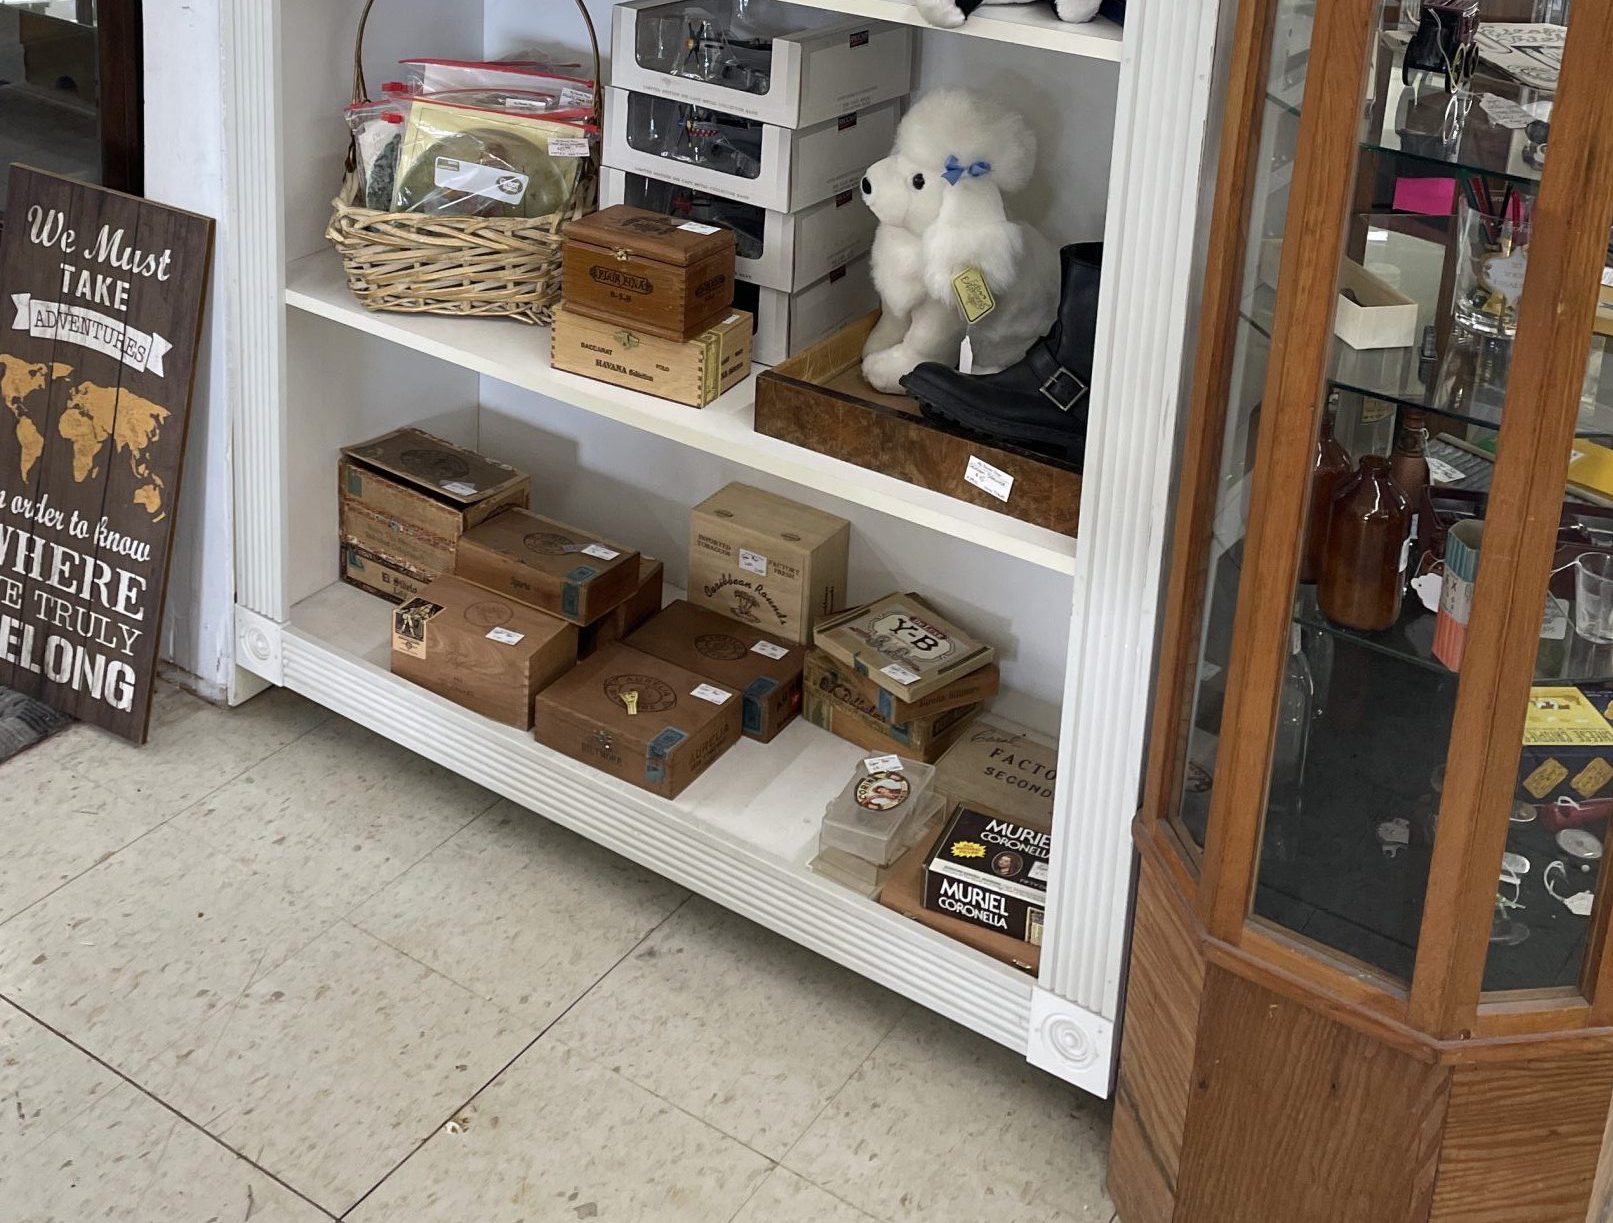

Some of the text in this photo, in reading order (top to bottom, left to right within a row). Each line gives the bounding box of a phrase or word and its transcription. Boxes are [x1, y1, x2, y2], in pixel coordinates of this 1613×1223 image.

[28, 205, 172, 281] We Must
[60, 263, 131, 312] TAKE
[34, 309, 147, 363] ADVENTURES
[596, 359, 627, 375] HAVANA
[11, 494, 64, 529] order
[69, 510, 90, 538] to
[93, 516, 151, 562] know
[0, 576, 144, 656] E TRULY
[704, 572, 787, 626] Caribbean Rounds
[889, 618, 940, 652] Y-B
[0, 614, 136, 712] ELONG
[984, 766, 1054, 800] SECOND
[989, 747, 1056, 781] FACTO
[985, 819, 1051, 849] MURIE
[938, 896, 1008, 930] CORONELLA
[940, 878, 1009, 917] MURIEL
